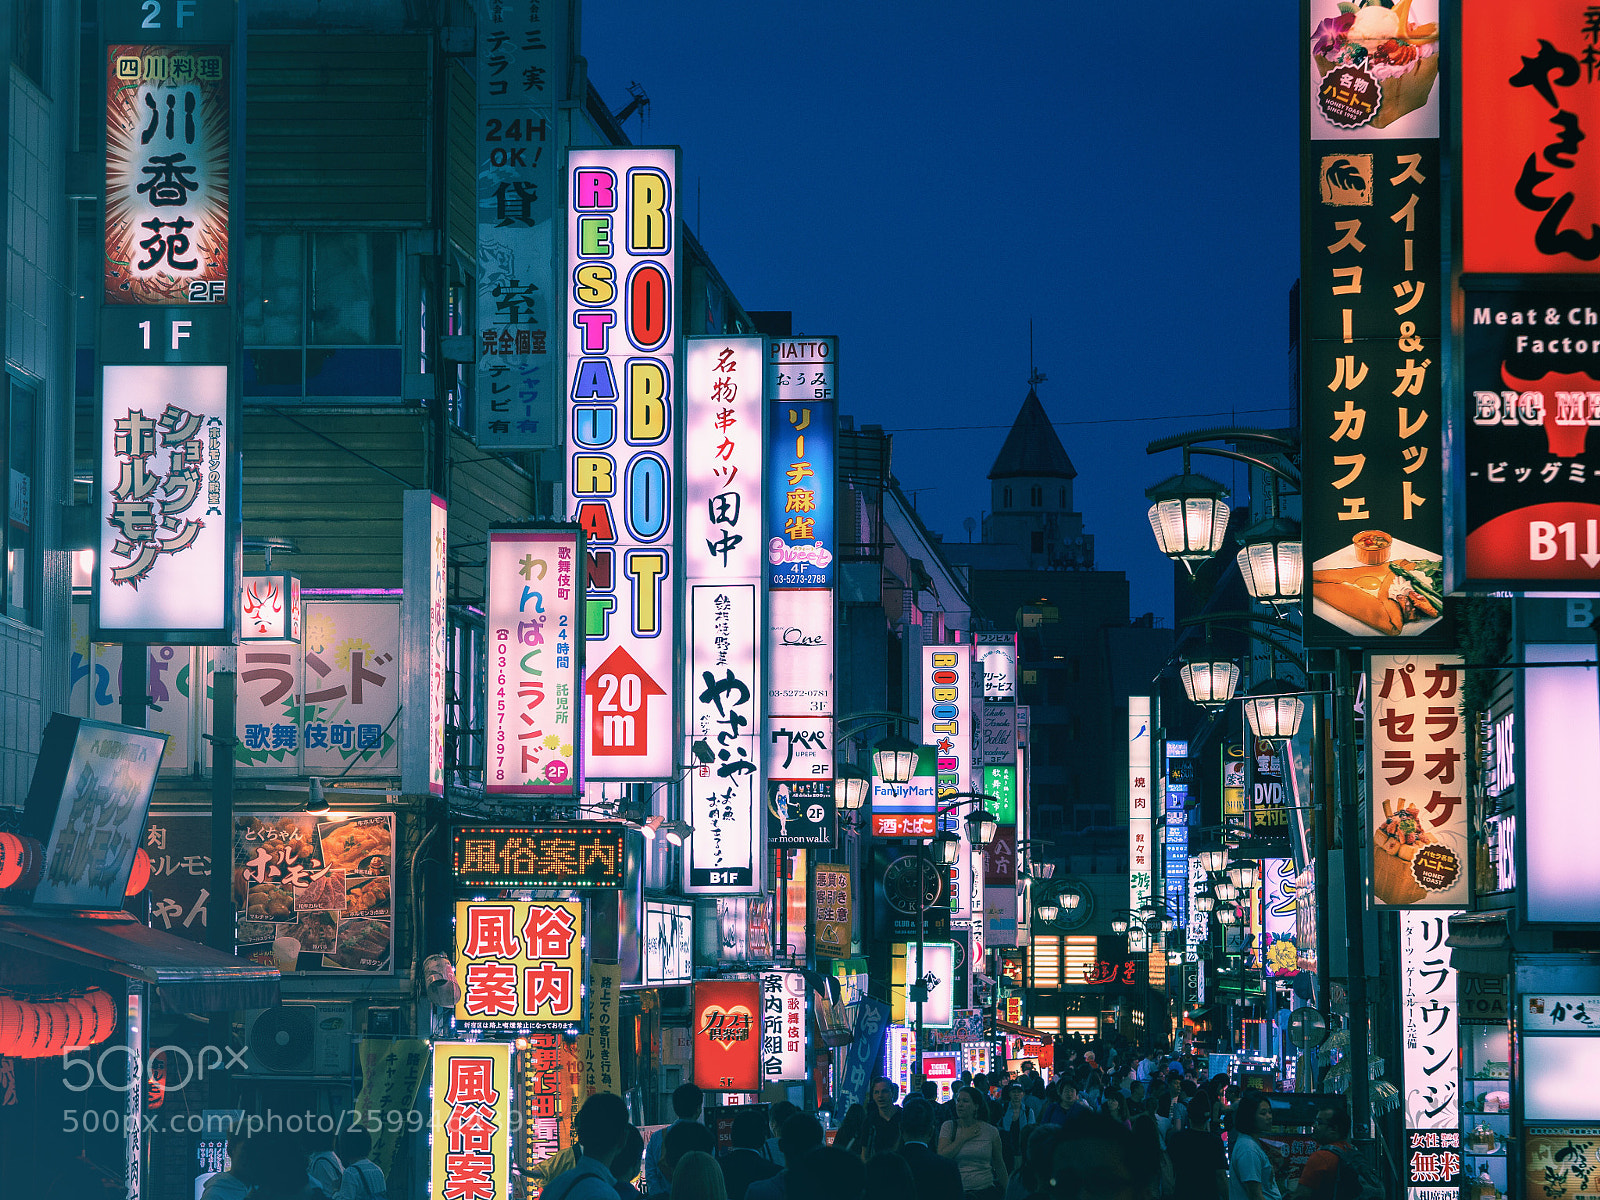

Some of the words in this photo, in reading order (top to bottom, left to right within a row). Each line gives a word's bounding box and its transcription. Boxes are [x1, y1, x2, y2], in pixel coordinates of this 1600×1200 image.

[118, 57, 223, 80] 四川料理
[486, 31, 510, 95] テラコ
[1340, 73, 1369, 93] 名物
[1325, 99, 1345, 109] HONEY
[1346, 105, 1363, 115] TOAST
[1327, 106, 1343, 115] SINCE
[485, 119, 546, 142] 24H
[490, 147, 542, 168] OK!
[1509, 38, 1600, 262] やきとん
[137, 91, 199, 272] 川香苑
[189, 281, 226, 303] 2F
[1473, 307, 1537, 326] Meat
[1545, 308, 1560, 325] &
[139, 321, 192, 350] 1F
[483, 329, 547, 355] 完全個室
[1390, 153, 1432, 520] スイーツ&ガレット
[770, 342, 830, 359] PIATTO
[776, 371, 828, 387] おうみ
[1327, 219, 1370, 521] スコールカフェ
[488, 365, 511, 434] テレビ有
[517, 363, 540, 434] シャワー有
[571, 166, 618, 641] RESTAURANT
[625, 166, 672, 639] ROBOT
[814, 388, 831, 399] 5F
[1473, 390, 1546, 426] BIG
[158, 404, 206, 554] ショーグン
[208, 427, 221, 505] ホルモンの殿堂
[784, 408, 816, 541] リーチ麻雀
[109, 408, 161, 590] ホルモン
[769, 537, 832, 568] Sweet
[558, 547, 571, 601] 歌舞伎町
[774, 575, 826, 584] 03-5273-2788
[791, 564, 810, 574] 4F
[556, 615, 570, 669] 24時間
[783, 626, 824, 645] One
[981, 634, 1011, 642] フジビル
[517, 554, 548, 774] わんぱくランド
[597, 673, 642, 713] 20
[932, 651, 960, 735] ROBOT
[985, 682, 1013, 691] サービス
[496, 643, 507, 781] 03-6457-3978
[555, 683, 570, 724] 託児所
[810, 701, 828, 711] 3F
[244, 723, 383, 751] 歌舞伎町園
[1378, 663, 1416, 787] パセラ
[772, 728, 828, 769] ウペペ
[1423, 664, 1462, 827] カラオケ
[548, 766, 565, 778] 2F
[812, 764, 829, 774] 2F
[874, 785, 934, 799] FamilyMart
[1134, 777, 1146, 809] 焼肉
[809, 808, 823, 819] 2F
[878, 818, 934, 835] 酒・たばこ
[148, 825, 167, 849] 肉
[245, 827, 303, 841] とくちゃん
[779, 835, 805, 843] moon
[806, 827, 831, 843] walk
[243, 846, 333, 888] ホルモン
[461, 837, 616, 875] 風俗案内
[995, 839, 1012, 874] 八方
[1417, 858, 1455, 871] ハニトー
[709, 871, 739, 884] B1F
[816, 871, 847, 888] 悪質な
[1422, 871, 1445, 881] HONEY
[1422, 876, 1443, 885] TOAST
[816, 889, 847, 905] 客引き
[816, 907, 848, 922] に注意
[463, 905, 576, 960] 風俗
[464, 961, 574, 1018] 案内
[600, 976, 612, 1096] 路上での客引き行為、
[698, 1011, 754, 1035] カブキ
[764, 974, 783, 1076] 案内所組合
[787, 997, 800, 1053] 歌舞伎町
[719, 1077, 734, 1087] 5F
[1410, 1132, 1440, 1148] 女性
